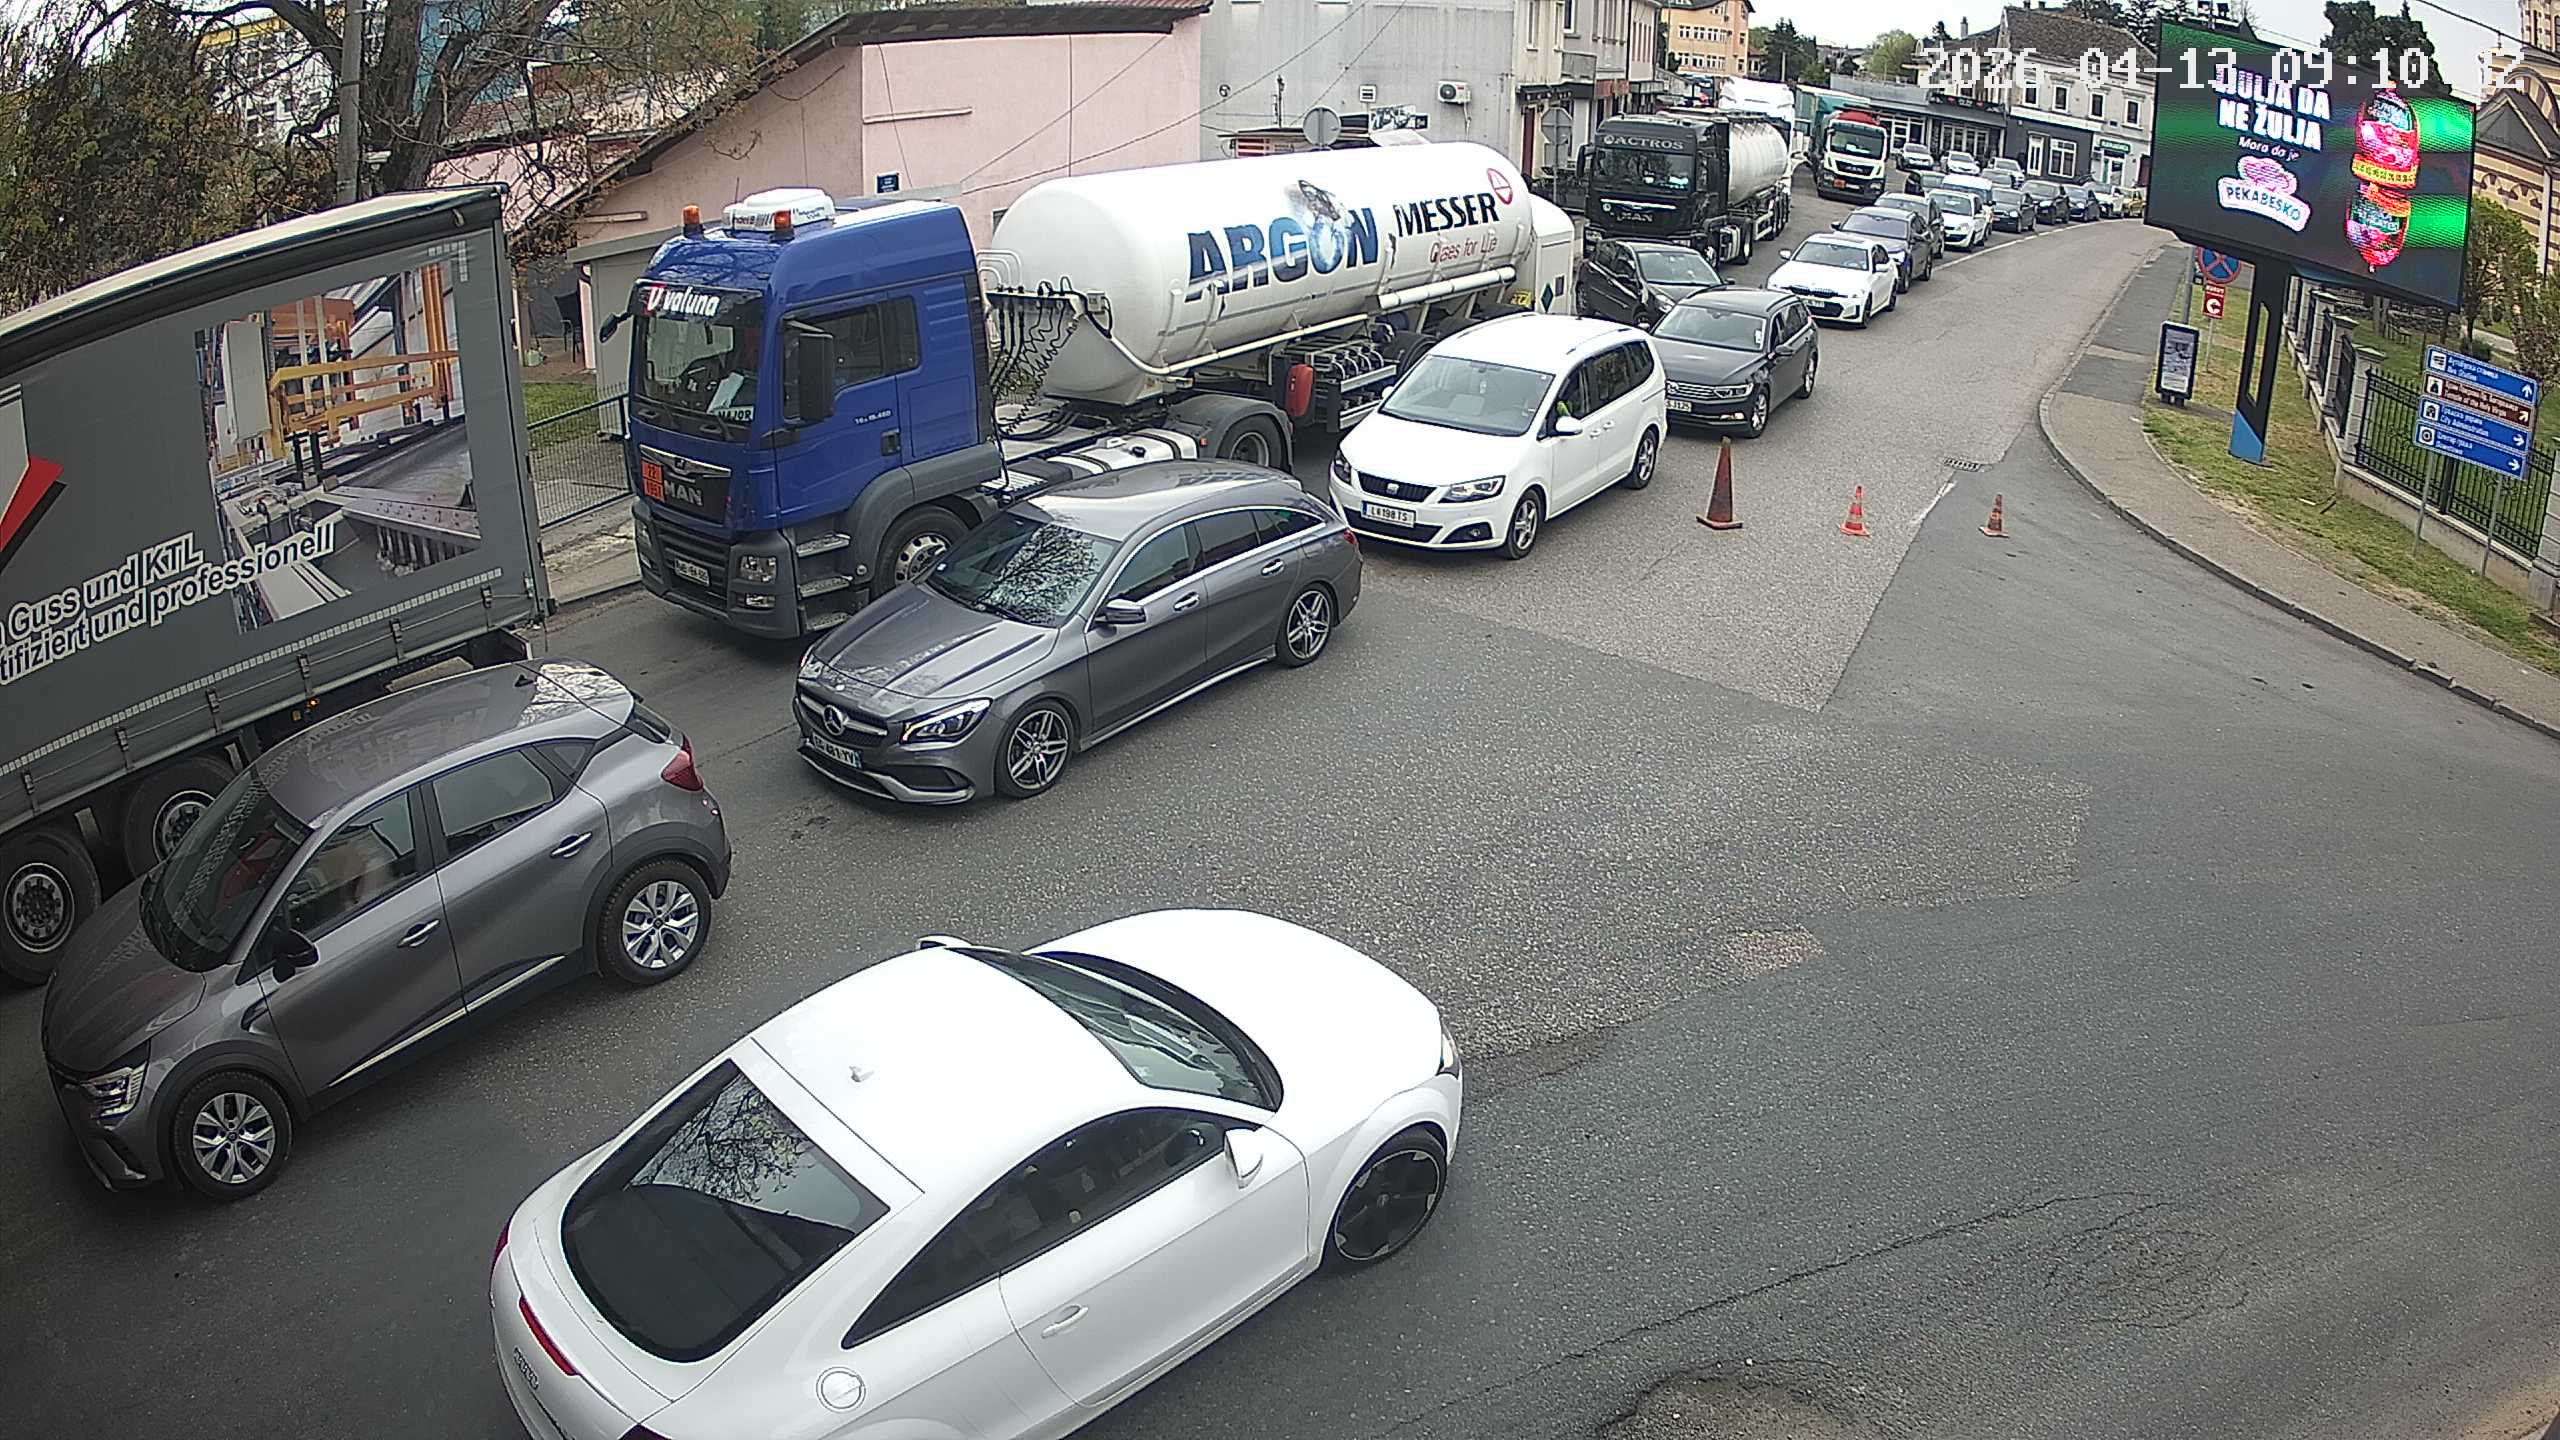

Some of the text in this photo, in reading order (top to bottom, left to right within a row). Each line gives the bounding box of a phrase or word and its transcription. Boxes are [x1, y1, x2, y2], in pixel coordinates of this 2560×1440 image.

[2219, 98, 2250, 131] NE
[2252, 102, 2322, 151] ŽULJA
[2297, 87, 2331, 120] DA
[1614, 137, 1684, 149] ACTROS
[1395, 192, 1500, 237] MESSER
[2226, 186, 2301, 221] PEKABESKO
[1185, 206, 1380, 303] ARGON
[664, 480, 703, 506] MAN
[11, 588, 79, 638] Guss
[84, 557, 138, 605] und
[143, 534, 202, 583] KTL
[92, 590, 147, 640] und
[150, 523, 335, 627] professionell
